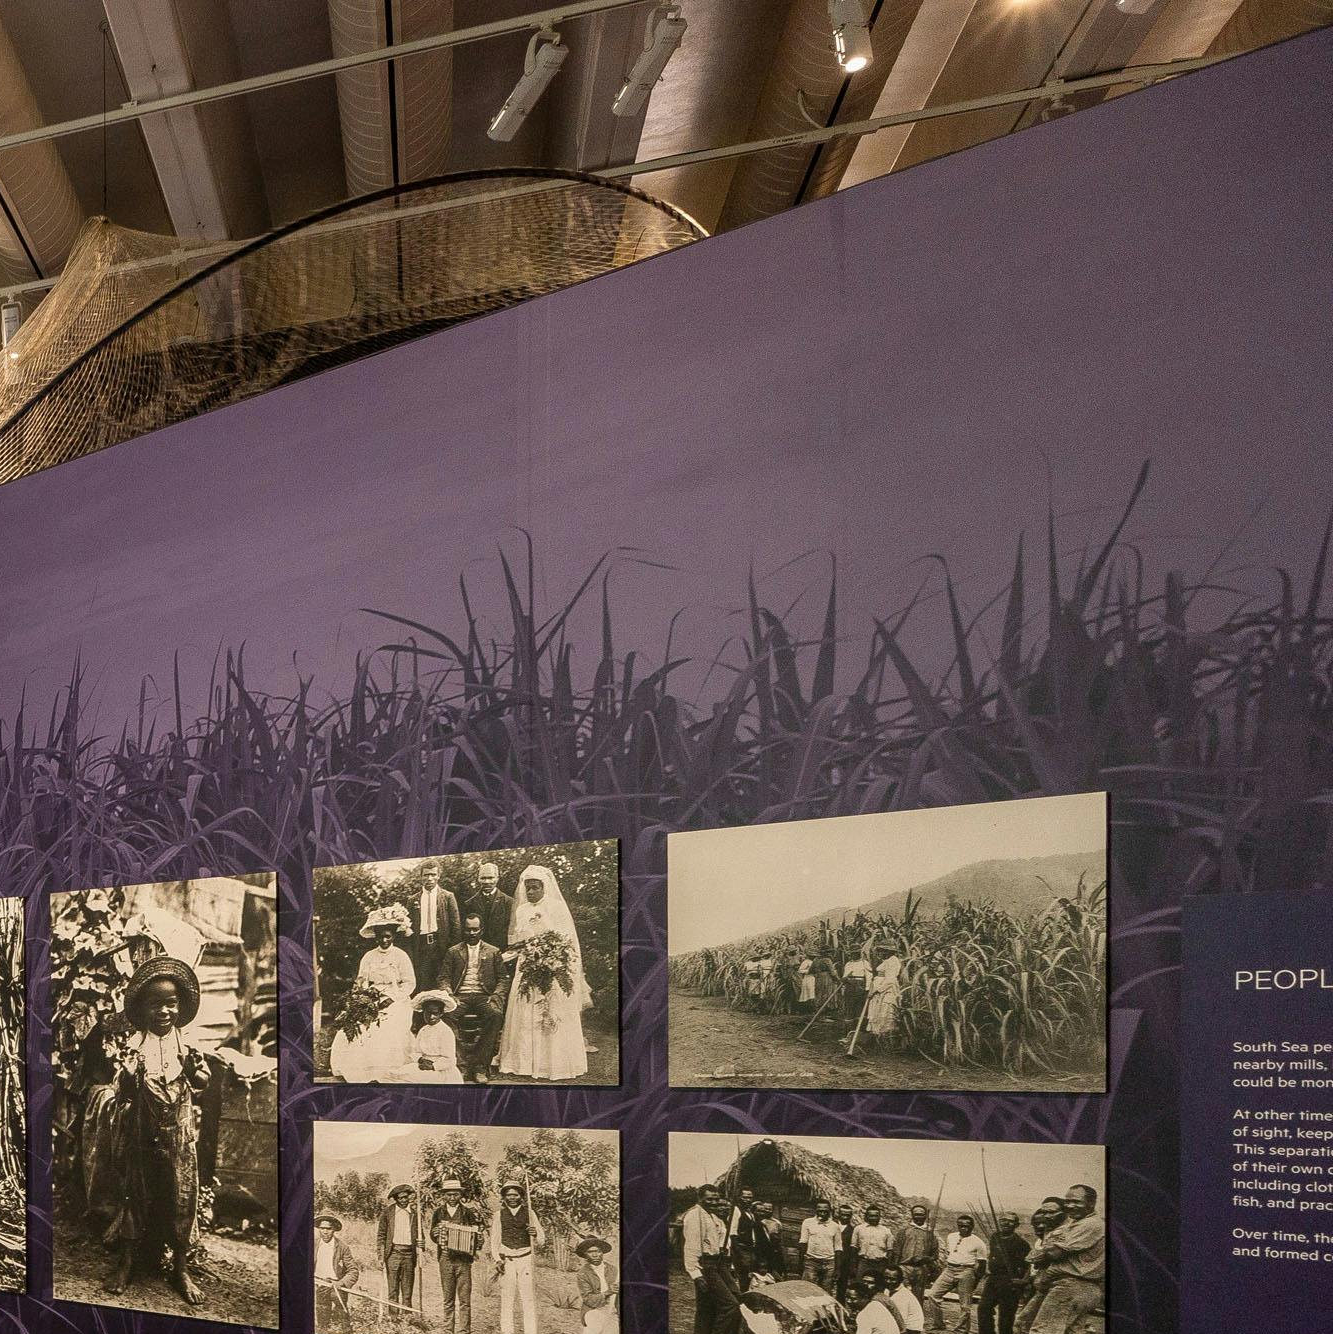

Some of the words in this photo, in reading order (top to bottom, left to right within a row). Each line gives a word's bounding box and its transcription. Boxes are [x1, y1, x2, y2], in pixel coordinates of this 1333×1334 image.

[1235, 969, 1333, 990] PEOPL
[1233, 1041, 1277, 1053] South
[1281, 1041, 1309, 1053] Sea
[1233, 1059, 1285, 1072] nearby
[1233, 1076, 1273, 1088] could
[1278, 1076, 1297, 1088] be
[1233, 1109, 1251, 1120] At
[1254, 1109, 1295, 1120] other
[1299, 1110, 1333, 1122] time
[1233, 1126, 1249, 1137] of
[1252, 1127, 1292, 1140] sight,
[1296, 1127, 1333, 1141] keep
[1233, 1143, 1265, 1155] This
[1269, 1146, 1333, 1158] separati
[1233, 1161, 1249, 1172] of
[1251, 1162, 1287, 1173] their
[1291, 1165, 1323, 1174] own
[1233, 1179, 1301, 1194] including
[1233, 1195, 1263, 1208] fish,
[1267, 1198, 1295, 1209] and
[1233, 1228, 1268, 1240] Over
[1272, 1230, 1310, 1244] time,
[1232, 1247, 1260, 1257] and
[1265, 1247, 1319, 1260] formed
[1323, 1252, 1333, 1261] c
